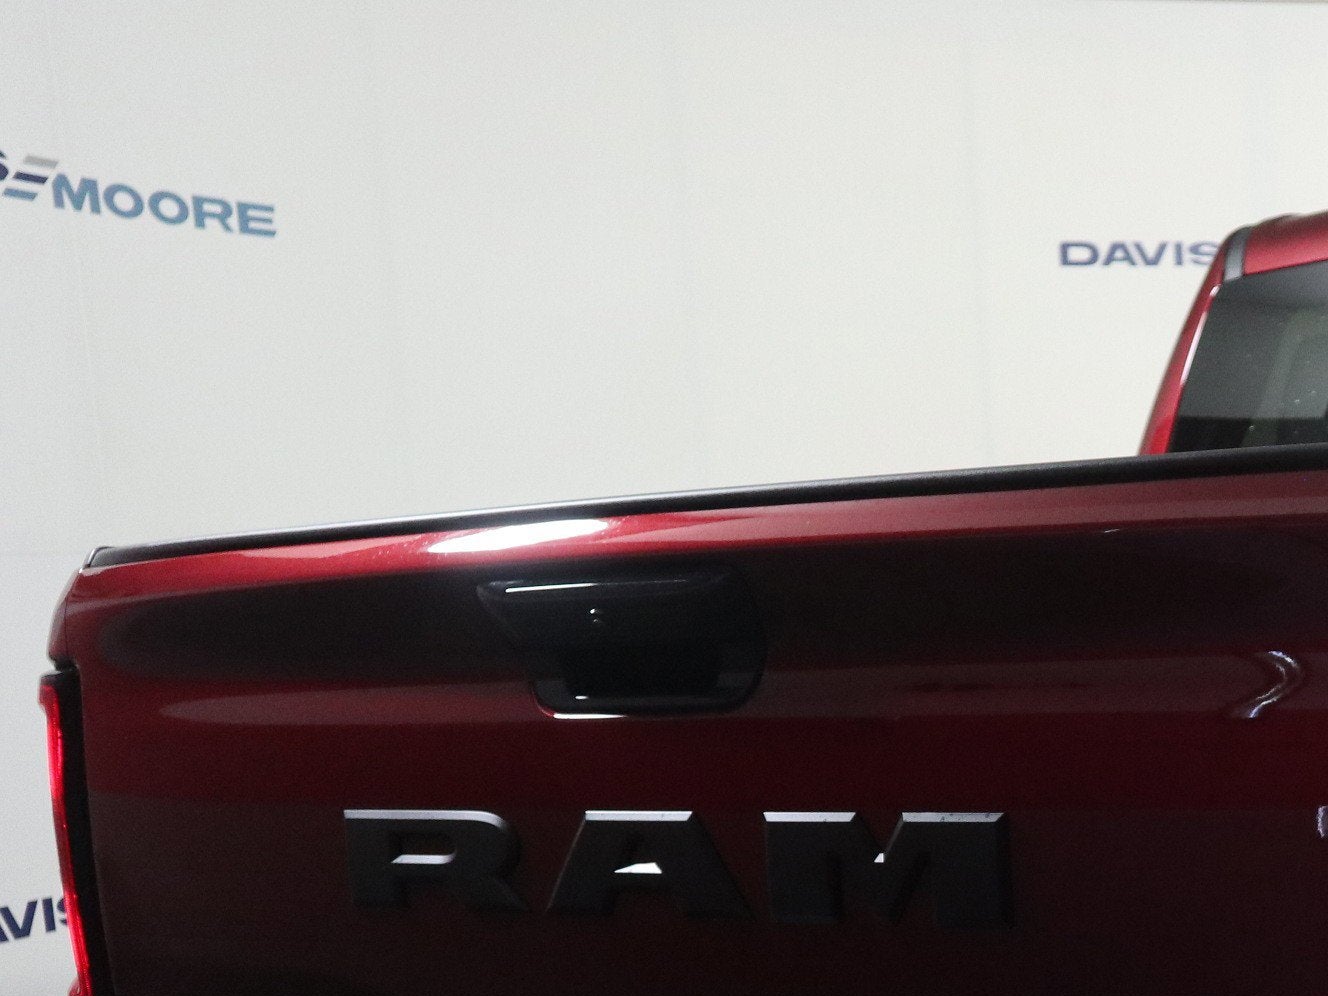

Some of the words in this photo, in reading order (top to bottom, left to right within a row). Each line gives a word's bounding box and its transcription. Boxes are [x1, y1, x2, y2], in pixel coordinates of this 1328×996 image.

[51, 173, 278, 238] MOORE
[1059, 240, 1221, 267] DAVIS
[343, 808, 1018, 932] RAM
[0, 896, 67, 943] VI
